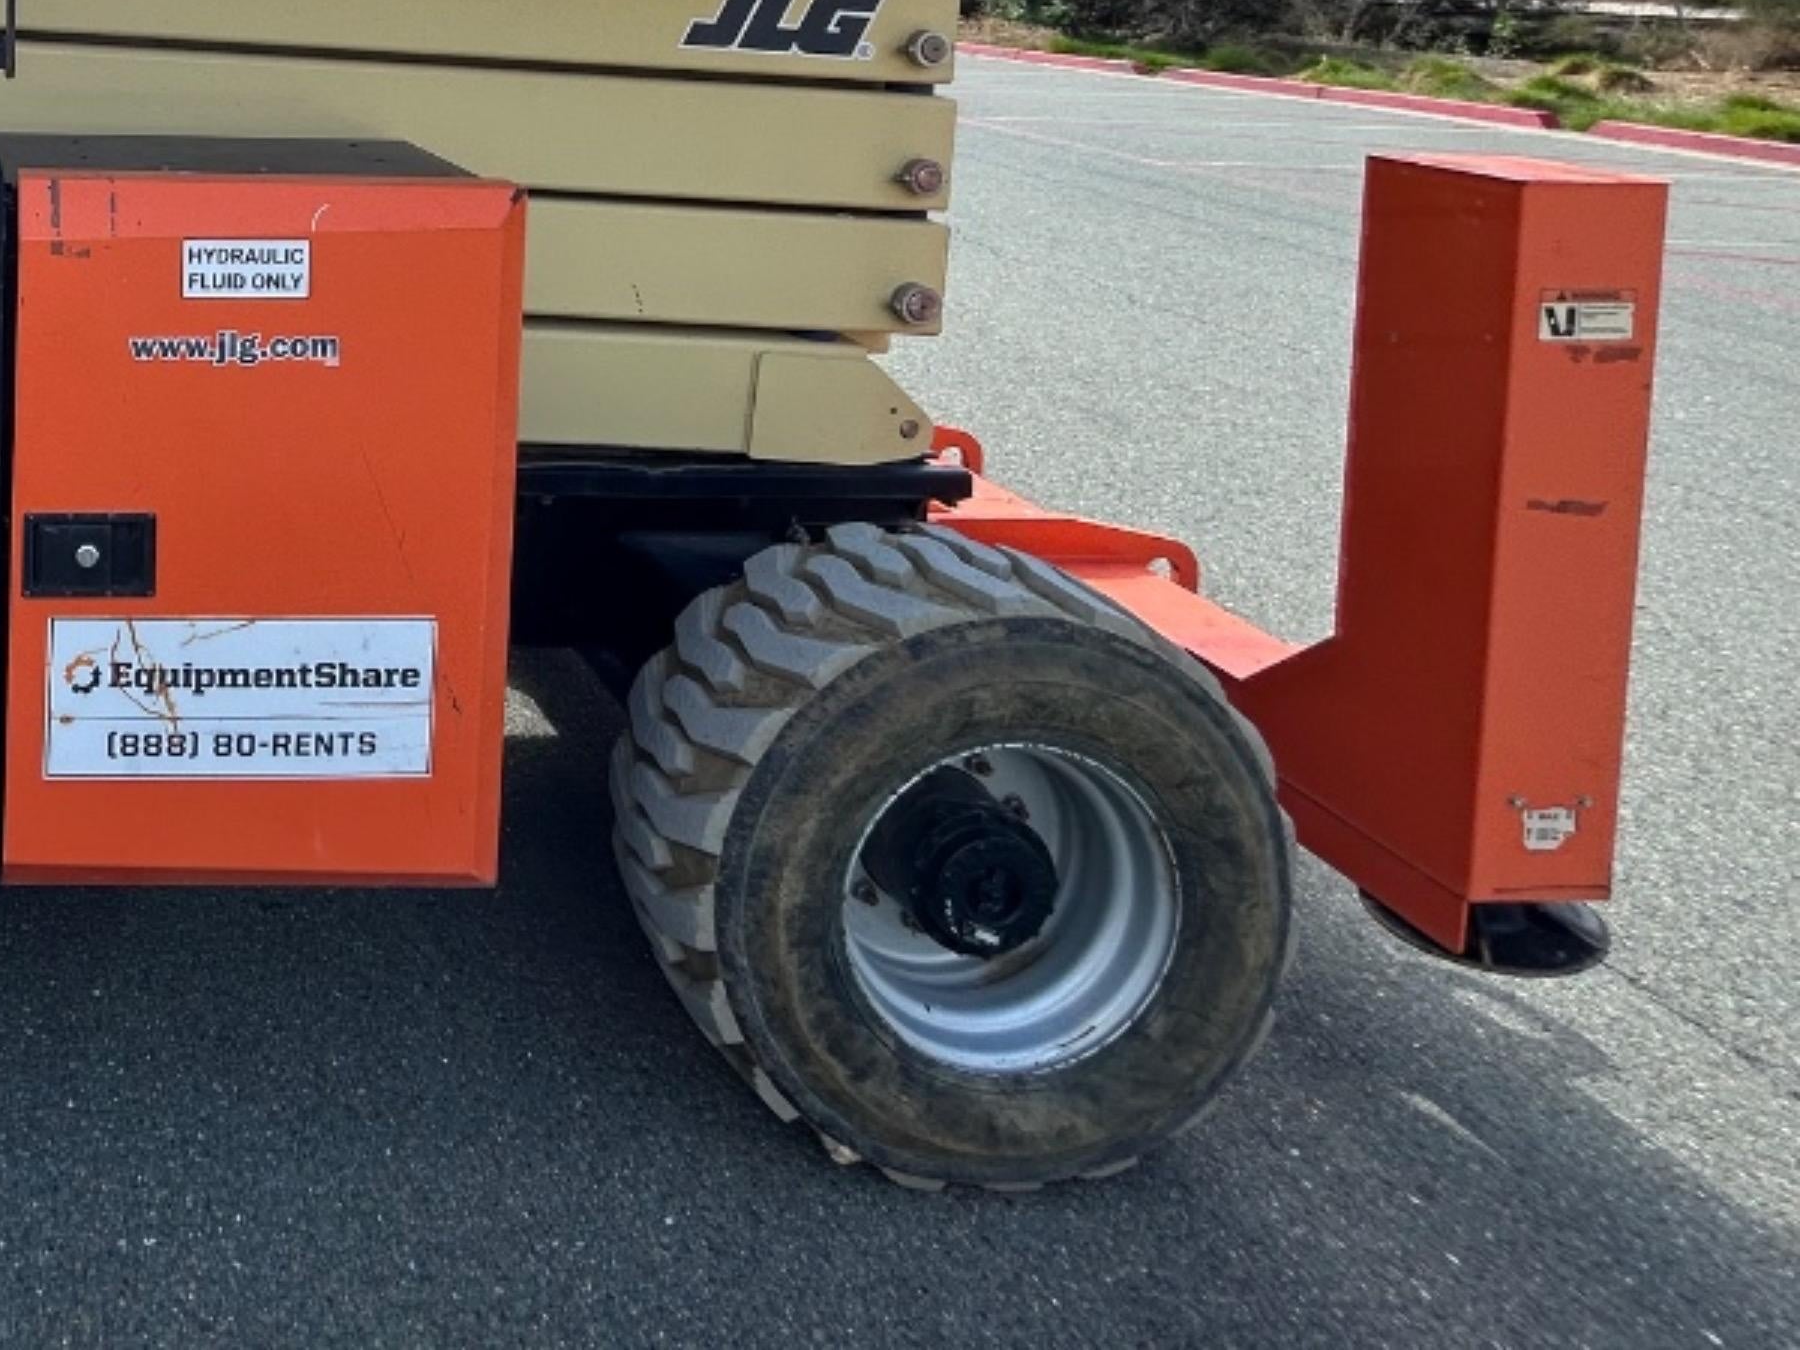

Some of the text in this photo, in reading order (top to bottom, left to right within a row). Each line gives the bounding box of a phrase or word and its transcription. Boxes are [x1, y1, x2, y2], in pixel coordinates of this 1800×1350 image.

[187, 247, 304, 265] HYDRAULIC
[188, 272, 304, 291] FLUID ONLY
[129, 330, 339, 366] www.jlg.com
[107, 662, 421, 696] EquipmentShare
[106, 731, 377, 759] (888) 80-RENTS
